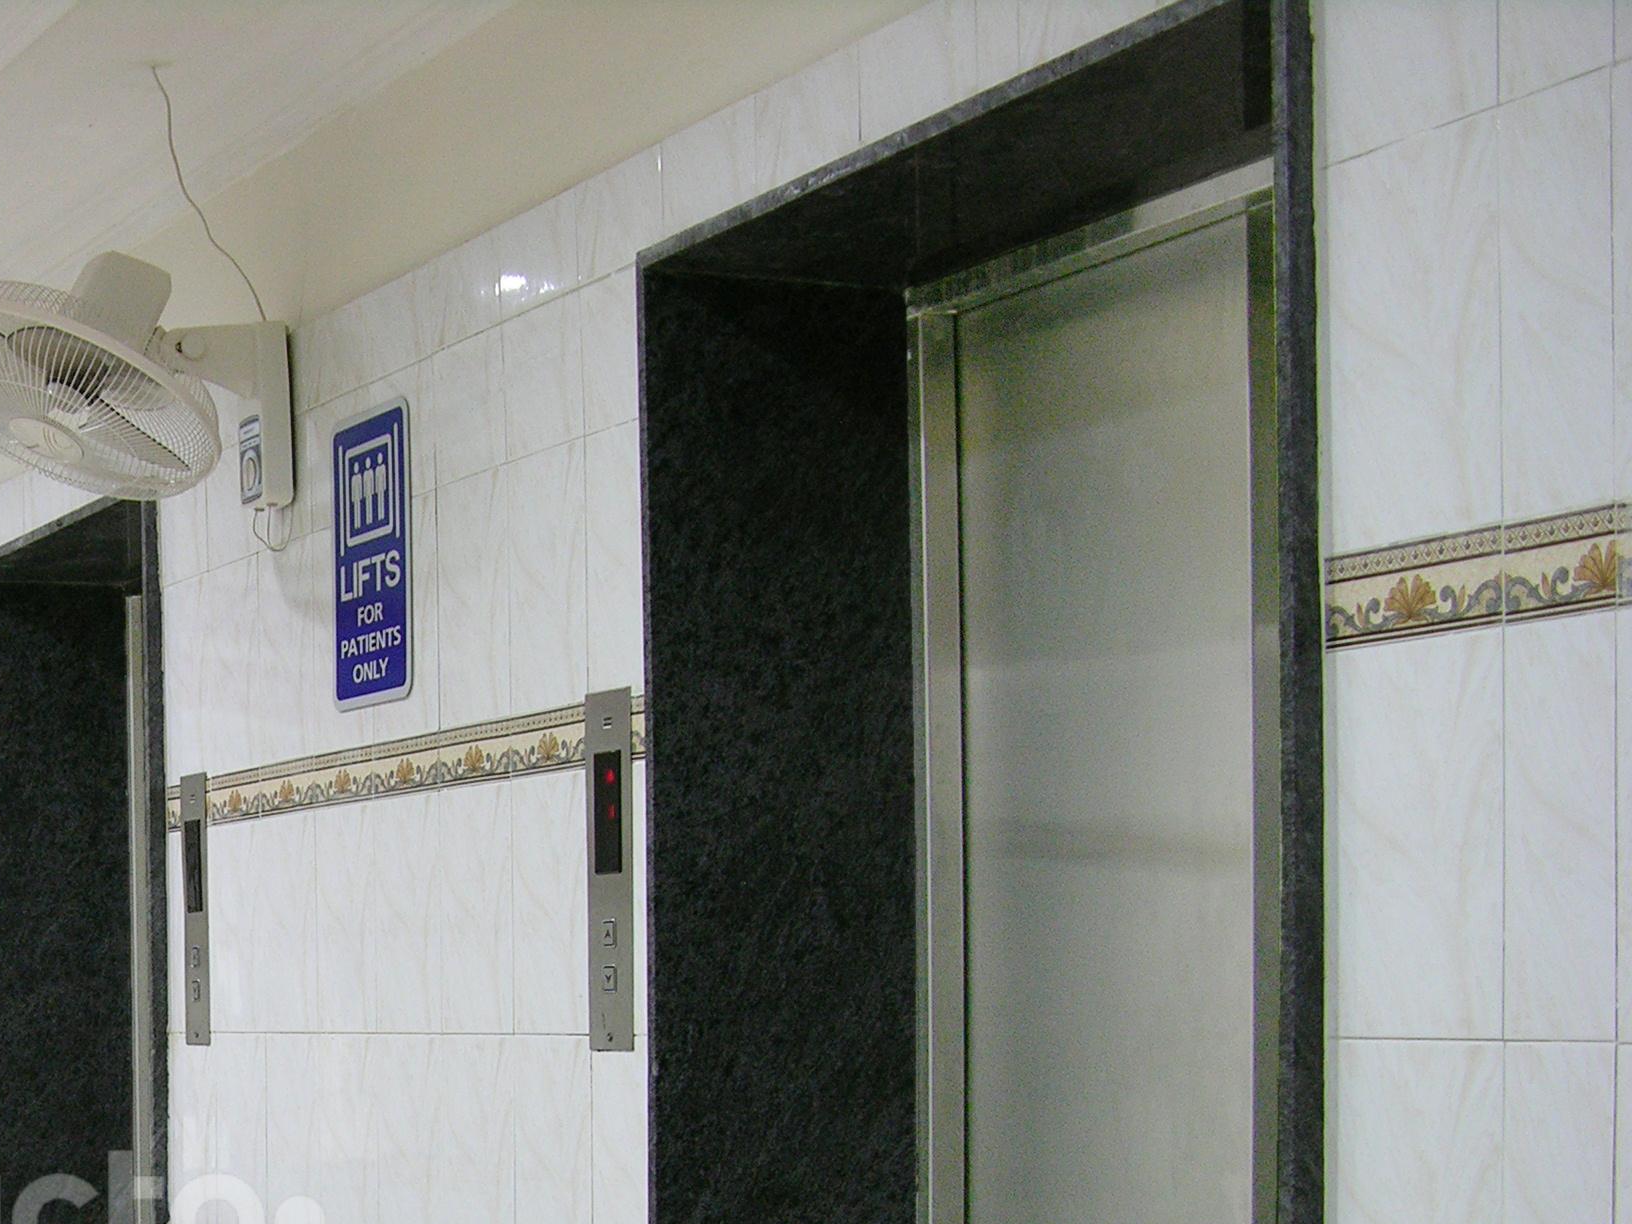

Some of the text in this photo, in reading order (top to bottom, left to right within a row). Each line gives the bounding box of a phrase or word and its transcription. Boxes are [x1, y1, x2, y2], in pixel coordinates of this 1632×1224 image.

[340, 550, 401, 602] LIFTS
[357, 604, 383, 627] FOR
[340, 626, 402, 659] PATIENTS
[352, 658, 389, 684] ONLY
